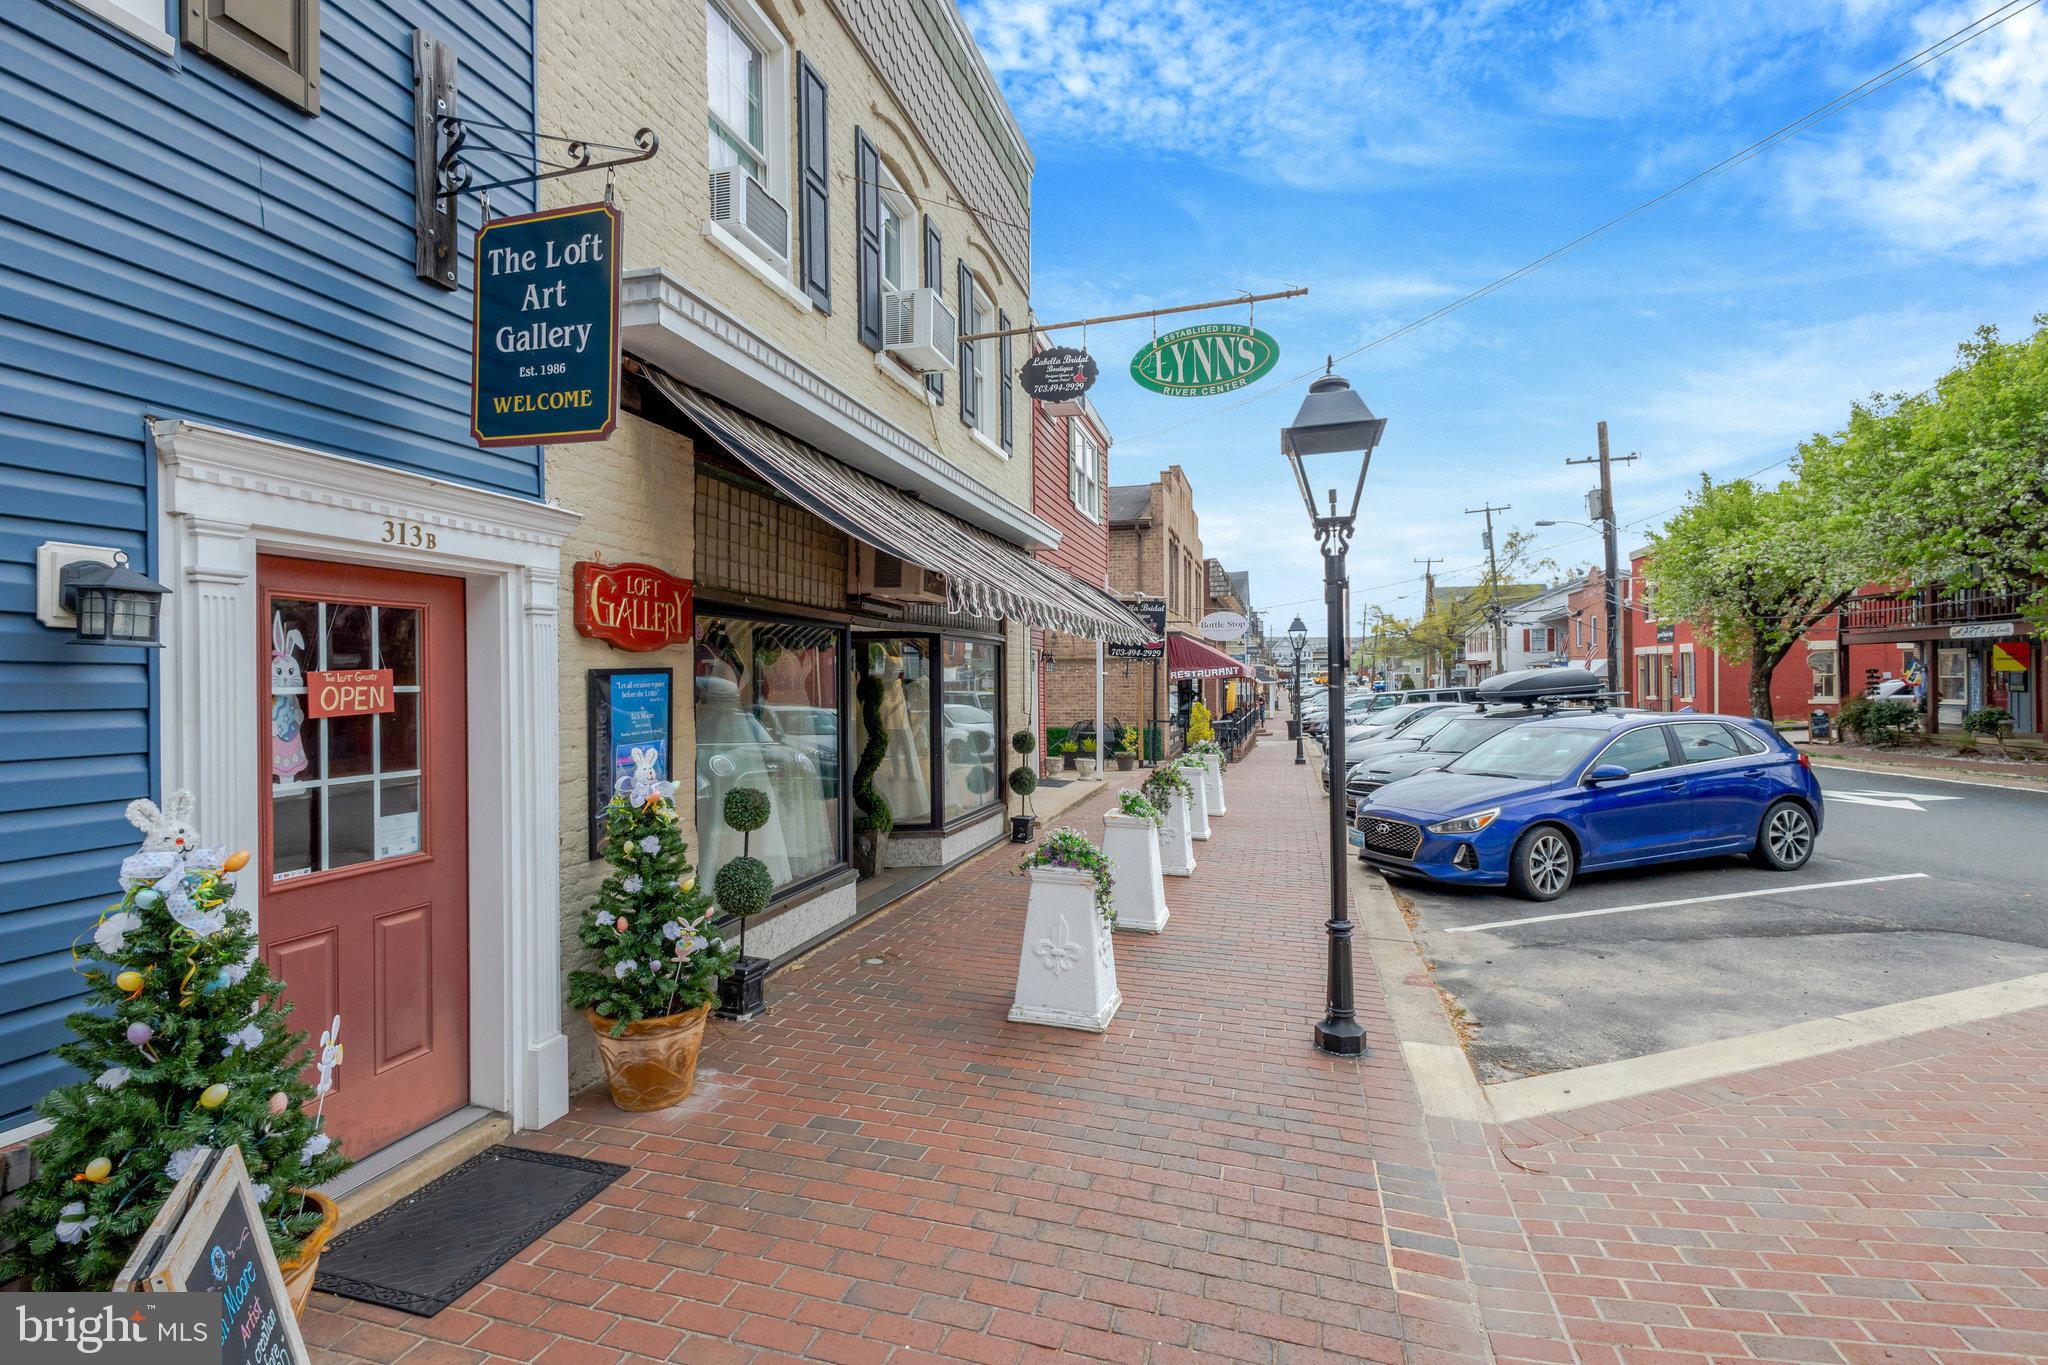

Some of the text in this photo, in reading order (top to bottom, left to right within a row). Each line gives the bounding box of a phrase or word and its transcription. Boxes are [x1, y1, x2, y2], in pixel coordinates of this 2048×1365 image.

[488, 233, 604, 276] The Loft
[521, 280, 567, 312] Art
[495, 322, 592, 353] Gallery
[1163, 325, 1242, 343] ESTABLISED 1917
[519, 363, 566, 378] Est. 1986
[1046, 365, 1074, 374] Boutique
[1063, 354, 1090, 365] Bridal
[1154, 336, 1255, 384] LYNN'S
[1163, 378, 1247, 396] RIVER CENTER
[493, 390, 592, 414] WELCOME
[626, 576, 661, 598] LOFT
[590, 574, 691, 640] GALLERY
[1140, 603, 1166, 612] Bridal
[1200, 620, 1246, 629] Bottle Stop
[1111, 648, 1162, 657] 703-494-2929
[1170, 666, 1240, 680] RESTAURANT
[320, 685, 385, 711] OPEN
[224, 1261, 256, 1325] Moore
[240, 1295, 263, 1350] Artist
[254, 1308, 277, 1364] creation
